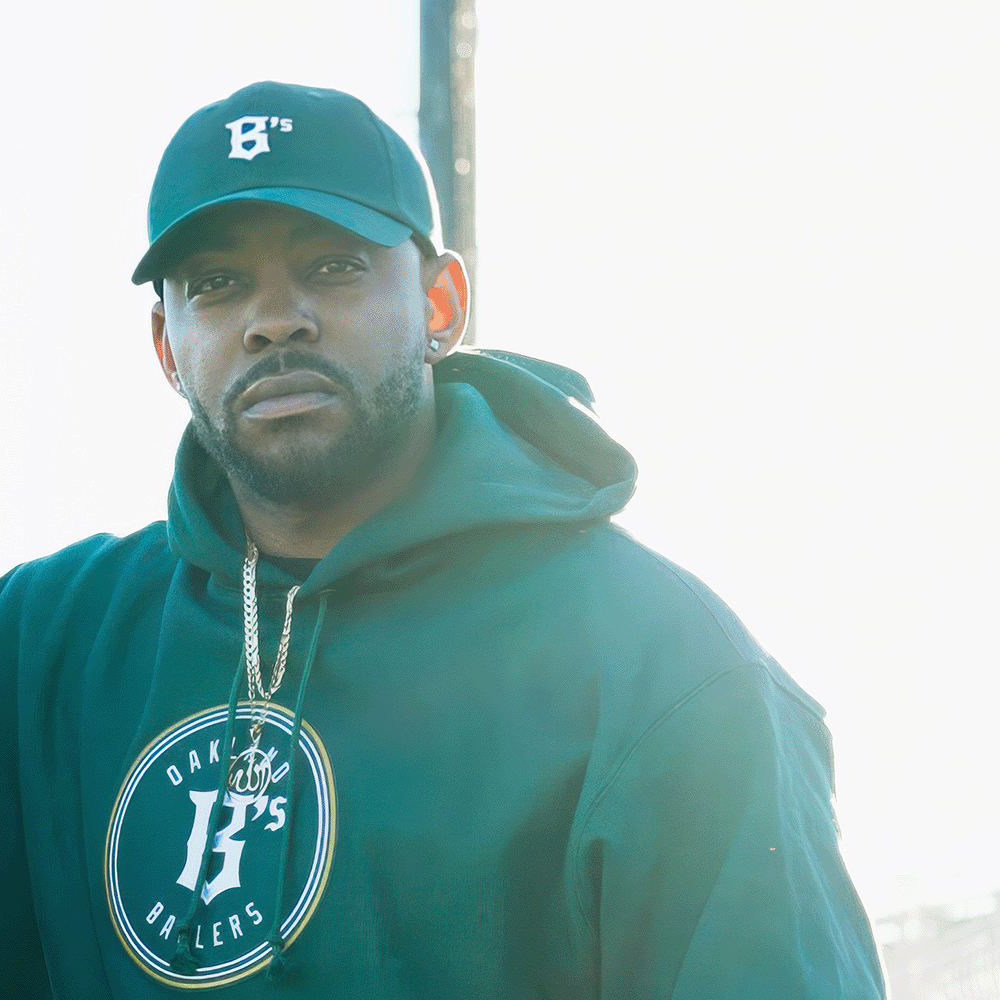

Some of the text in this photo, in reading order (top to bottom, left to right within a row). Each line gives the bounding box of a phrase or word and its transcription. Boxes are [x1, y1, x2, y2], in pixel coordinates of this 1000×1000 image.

[225, 115, 293, 161] B's
[176, 789, 288, 906] B's
[146, 901, 263, 949] BALERS
